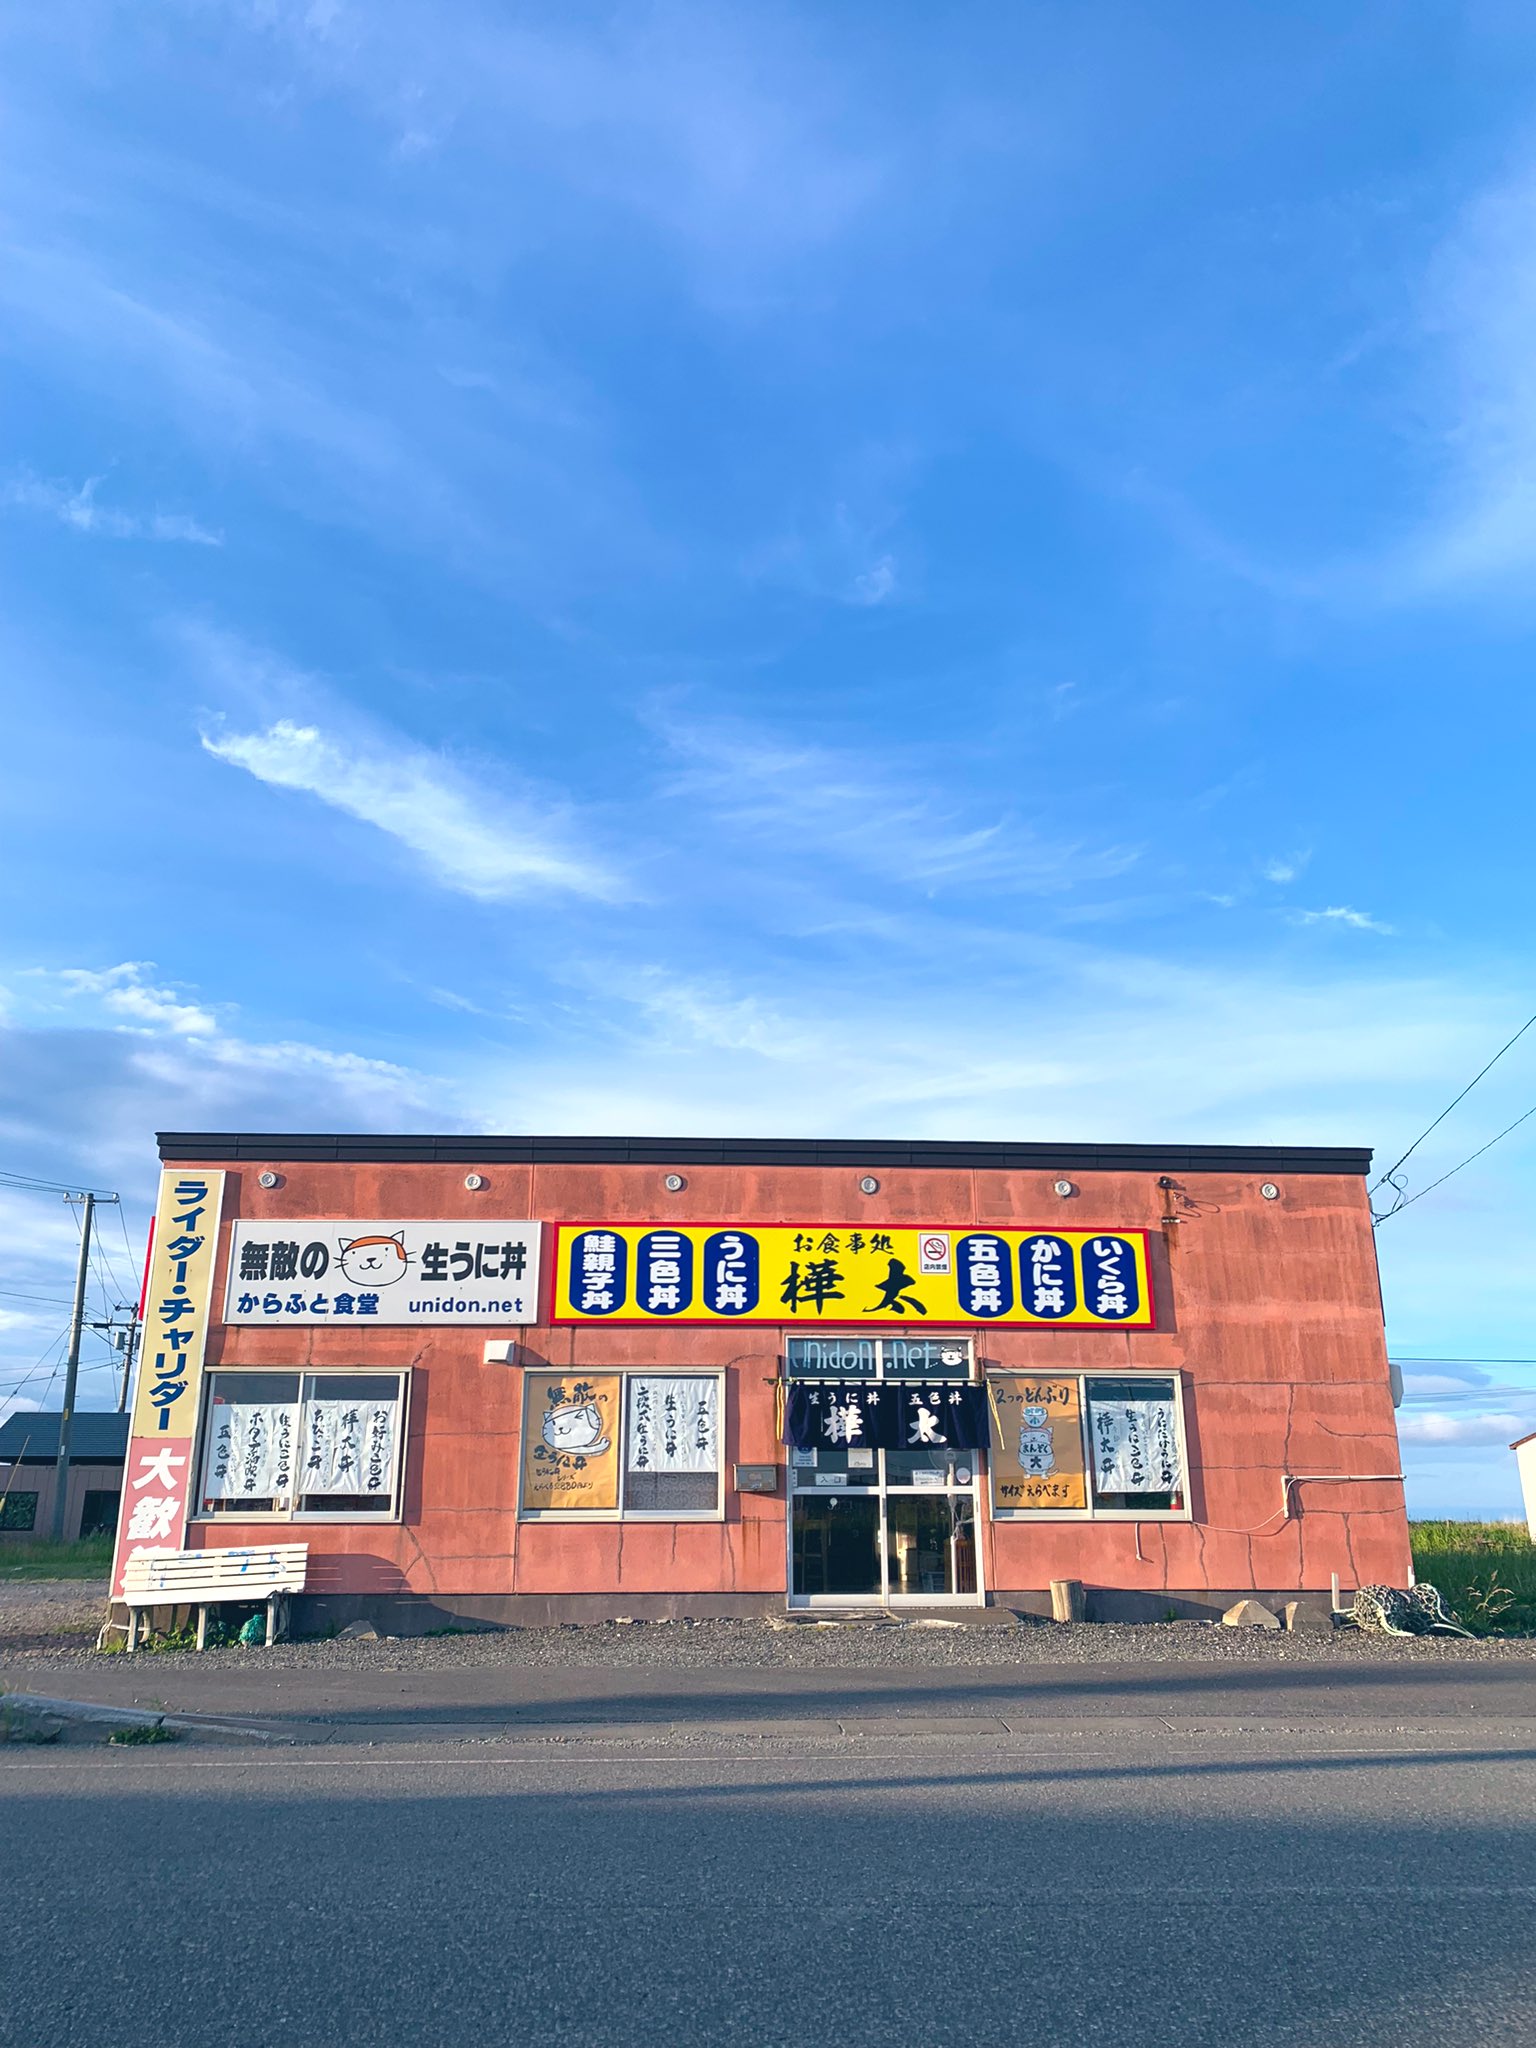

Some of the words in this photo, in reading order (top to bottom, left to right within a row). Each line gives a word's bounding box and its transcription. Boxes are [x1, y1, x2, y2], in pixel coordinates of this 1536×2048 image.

[239, 1240, 329, 1281] 無敵の
[420, 1241, 527, 1281] 生うに丼
[580, 1234, 616, 1310] 鮭親子丼
[648, 1235, 681, 1310] 三色丼
[715, 1235, 748, 1310] うに丼
[793, 1232, 894, 1255] お食事処
[967, 1239, 1003, 1314] 五色丼
[1030, 1239, 1065, 1314] かに丼
[1093, 1239, 1129, 1315] いくら丼
[149, 1181, 209, 1431] ライダー・チャリダー
[237, 1292, 379, 1316] からふと食堂
[409, 1296, 523, 1315] unidon.net
[780, 1257, 929, 1316] 樺太
[808, 1391, 881, 1406] 生うに丼
[908, 1391, 963, 1406] 五色丼
[823, 1404, 947, 1444] 樺太
